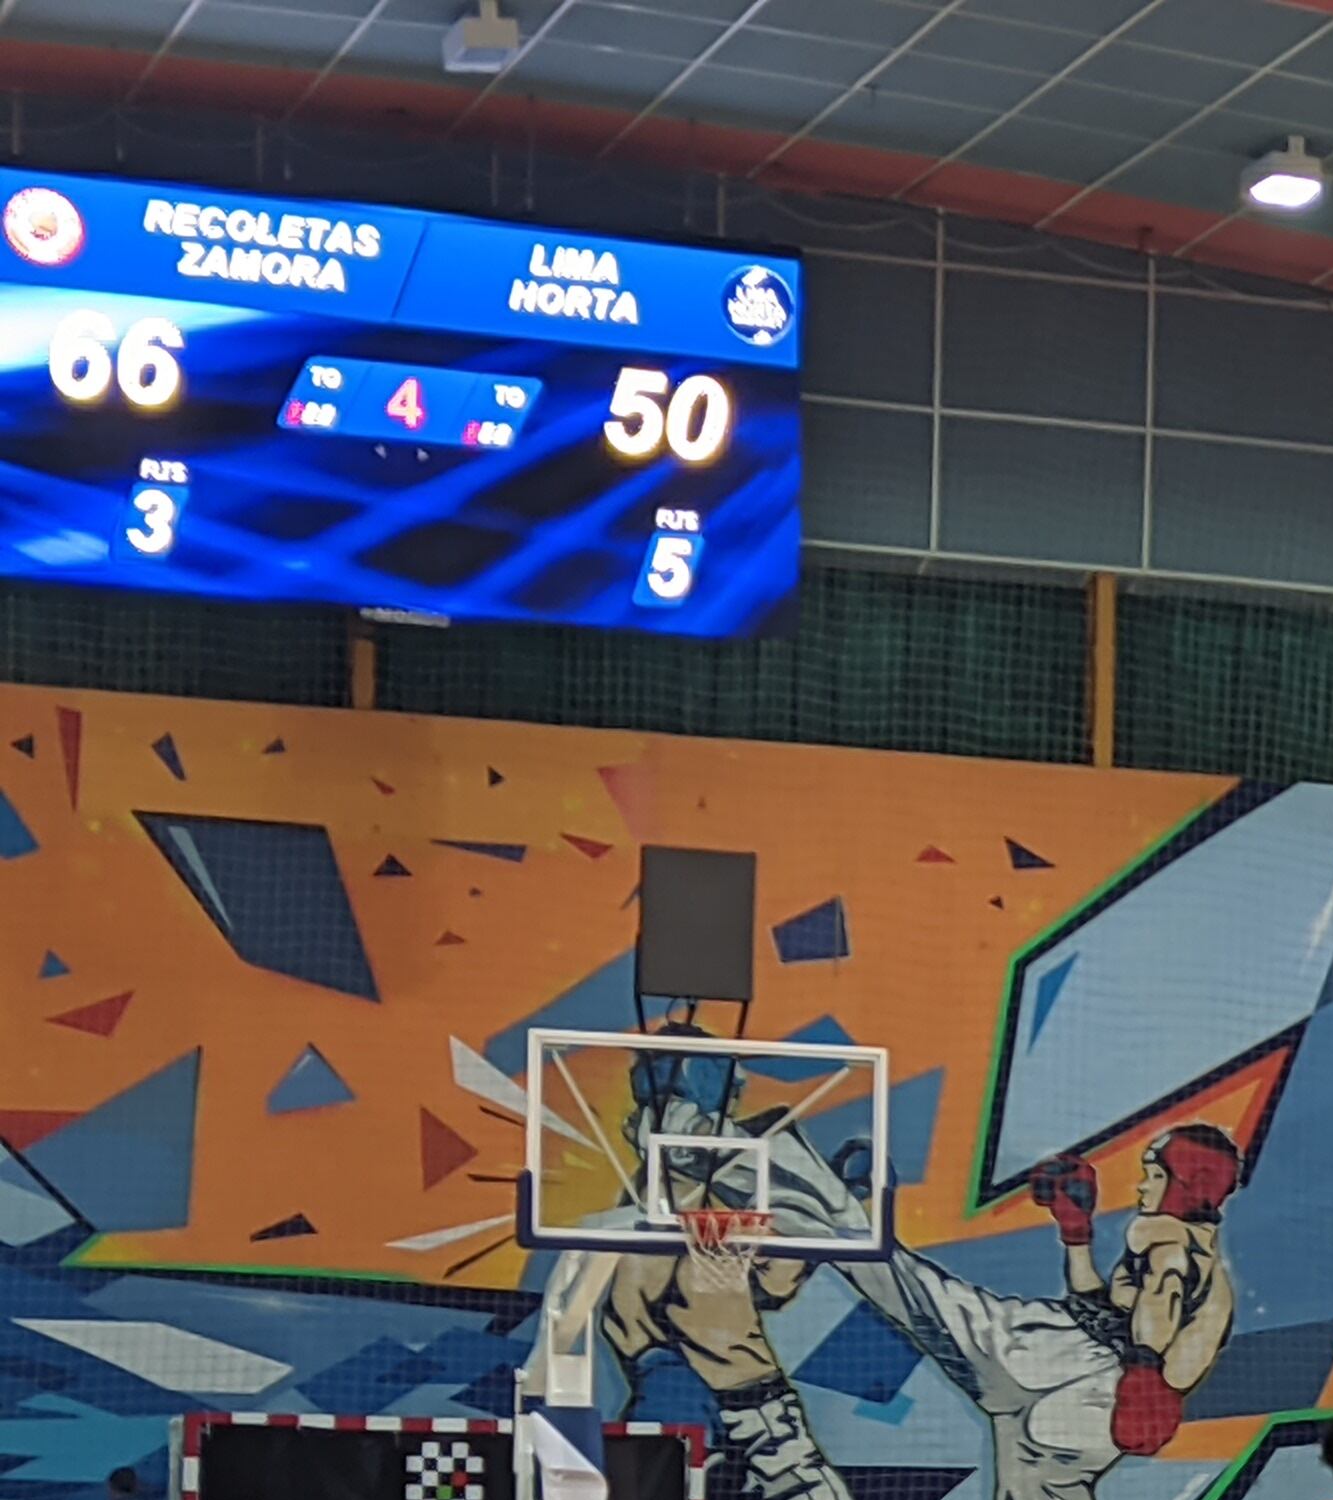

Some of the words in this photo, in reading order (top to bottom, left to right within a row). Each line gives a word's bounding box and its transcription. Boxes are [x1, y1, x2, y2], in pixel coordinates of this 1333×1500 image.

[143, 199, 381, 258] RECOLETAS
[176, 240, 346, 293] ZAMORA
[529, 243, 619, 286] LIMA
[508, 278, 639, 325] HORTA
[49, 309, 185, 407] 66
[387, 377, 424, 428] 4
[603, 367, 730, 462] 50
[127, 489, 175, 554] 3
[647, 537, 690, 599] 5
